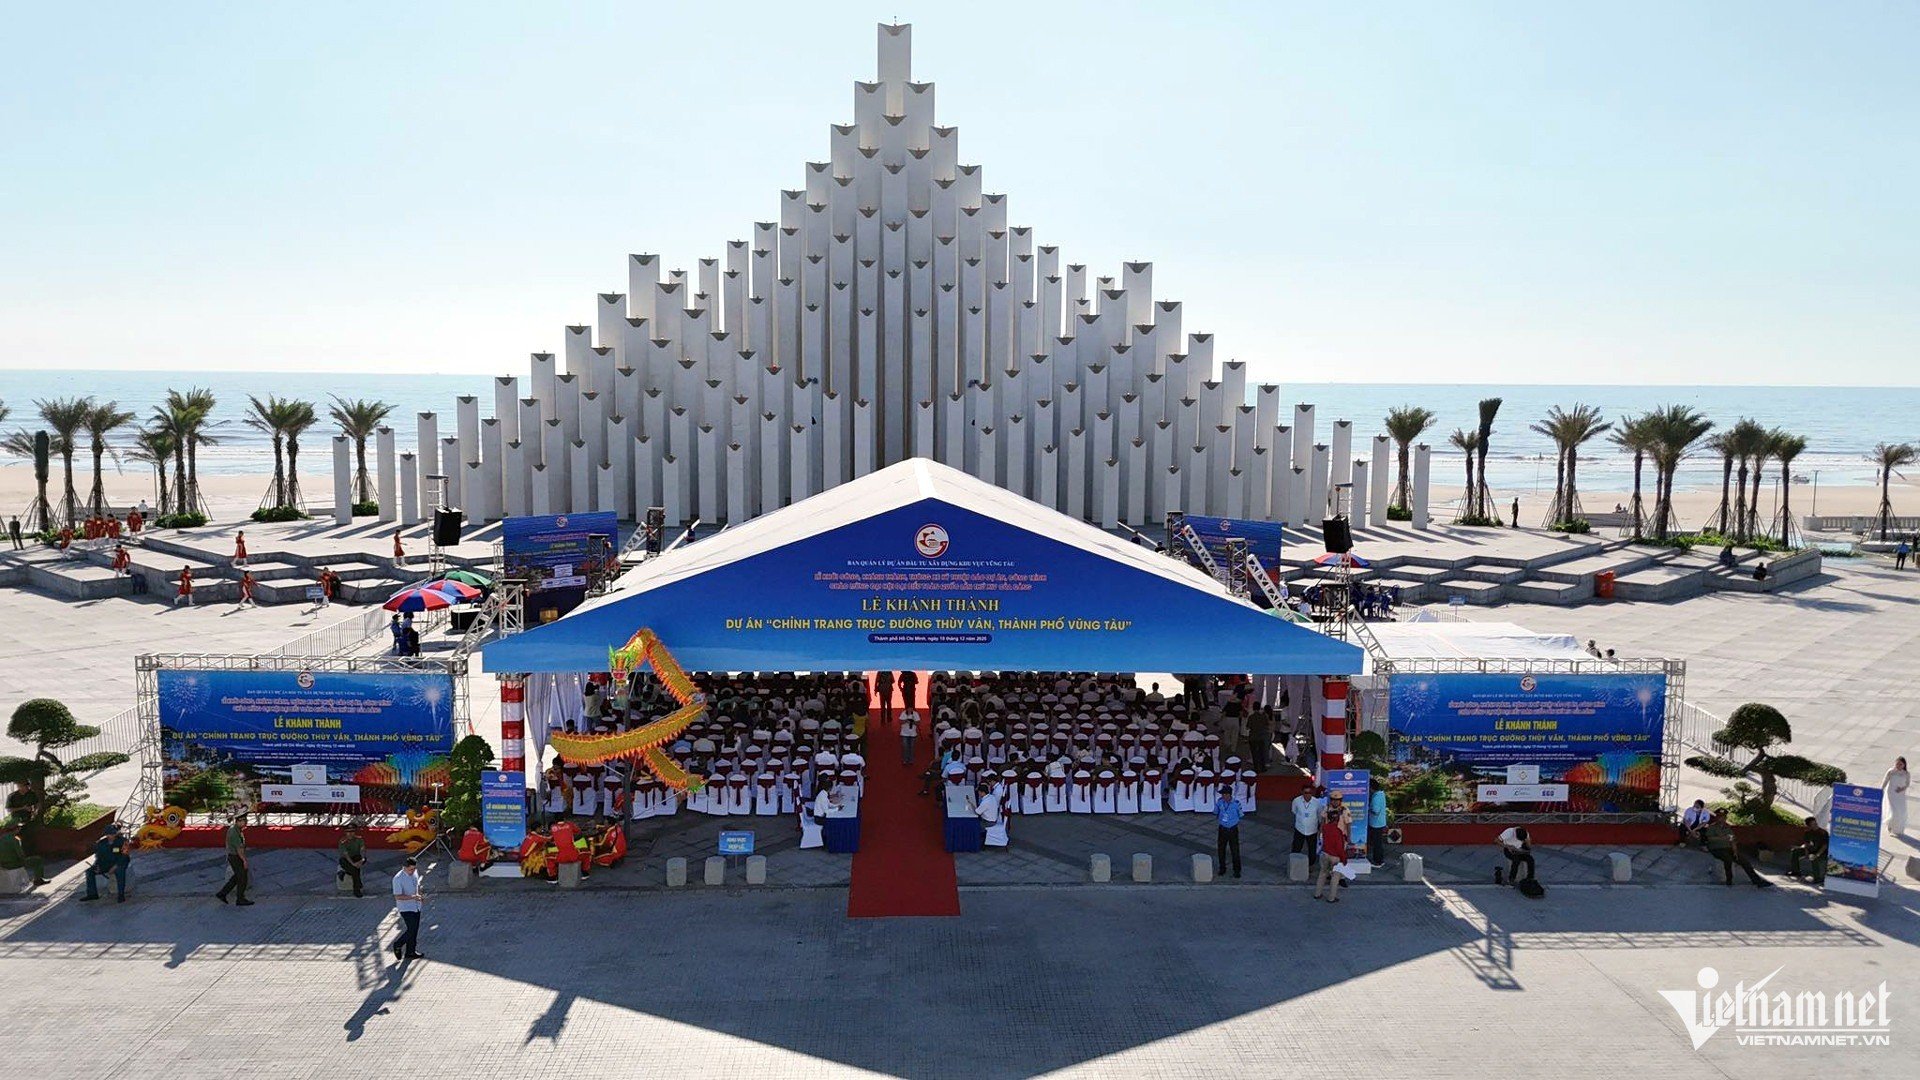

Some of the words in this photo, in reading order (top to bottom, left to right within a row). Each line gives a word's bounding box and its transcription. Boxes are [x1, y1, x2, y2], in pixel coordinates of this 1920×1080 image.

[862, 596, 882, 611] LỄ
[886, 596, 941, 611] KHÁNH
[945, 596, 999, 611] THÀNH
[726, 618, 743, 632] DỰ
[745, 616, 763, 629] ÁN
[814, 619, 852, 629] TRANG
[856, 619, 885, 632] TRỤC
[889, 616, 932, 629] ĐƯỜNG
[935, 617, 964, 629] THÙY
[968, 617, 995, 631] VÂN,
[998, 617, 1037, 629] THÀNH
[1040, 616, 1064, 630] PHỐ
[1068, 618, 1101, 630] VŨNG
[274, 716, 284, 728] LỄ
[285, 718, 312, 728] KHÁNH
[316, 718, 342, 728] THÀNH
[1495, 718, 1504, 730] LỄ
[1505, 720, 1531, 730] KHÁNH
[1533, 719, 1557, 730] THÀNH
